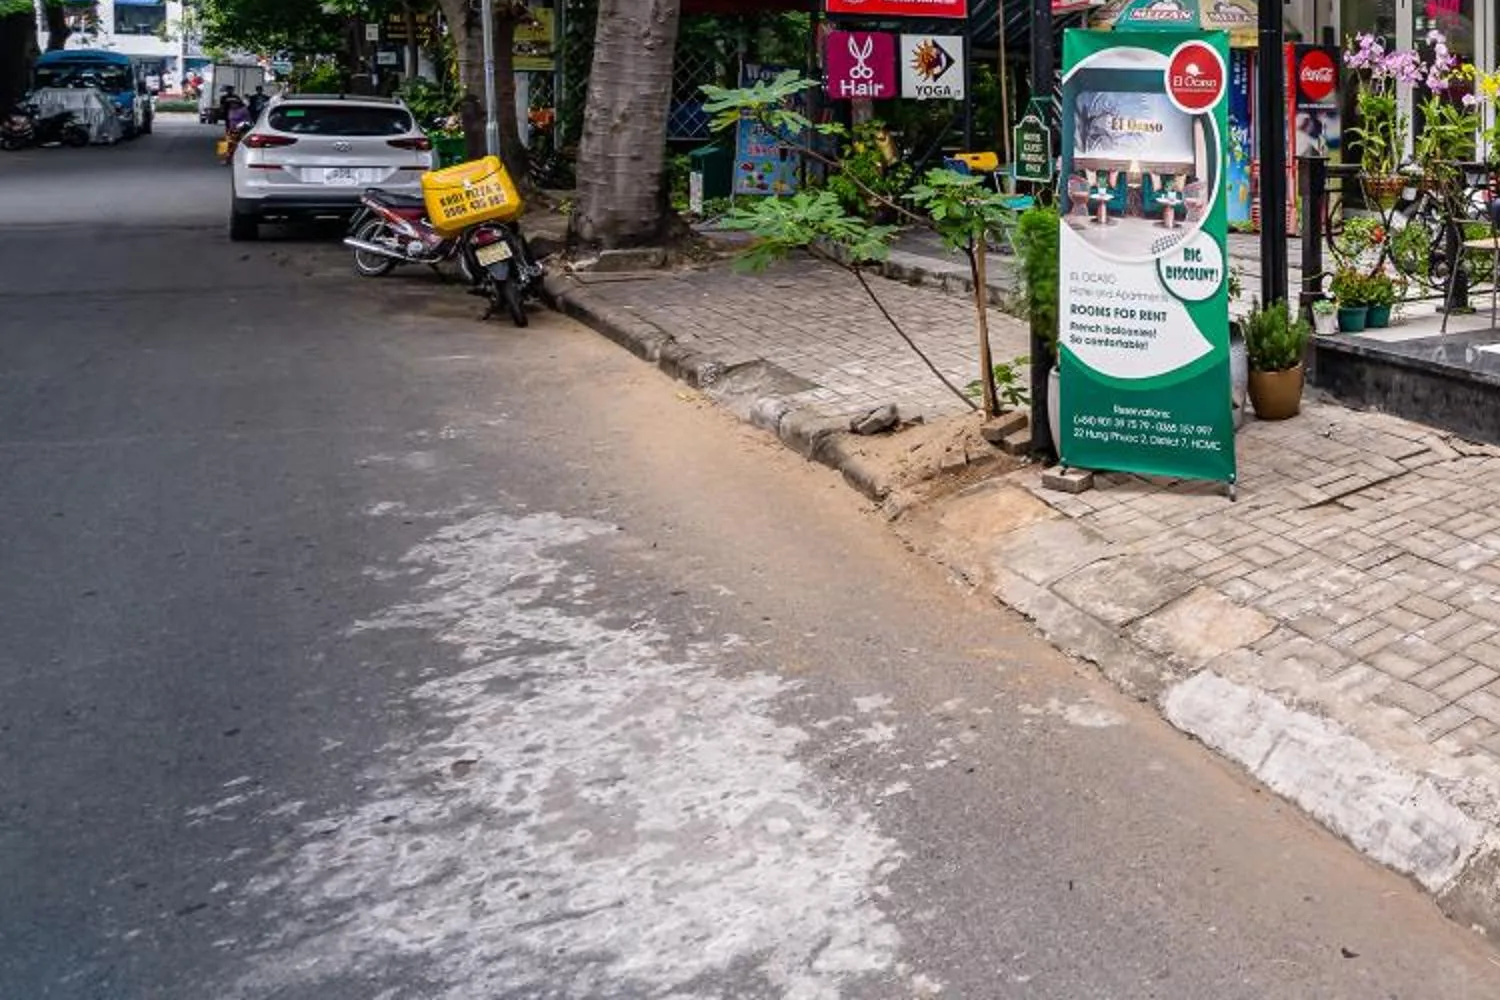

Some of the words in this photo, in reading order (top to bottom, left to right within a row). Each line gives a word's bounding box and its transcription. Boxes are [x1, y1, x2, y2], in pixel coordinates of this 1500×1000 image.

[840, 80, 884, 97] Hair
[1173, 75, 1183, 87] El
[1184, 76, 1217, 88] Ocaso
[915, 85, 951, 98] YOGA
[1183, 247, 1203, 263] BIG
[1165, 266, 1219, 283] DISCOUNT!
[1070, 303, 1111, 318] ROOMS
[1114, 307, 1136, 320] FOR
[1139, 310, 1168, 322] RENT
[1070, 321, 1102, 333] French
[1070, 334, 1082, 345] So
[1084, 336, 1149, 350] comfortable!
[1113, 404, 1171, 419] Reservations:
[1191, 439, 1221, 451] HCMC
